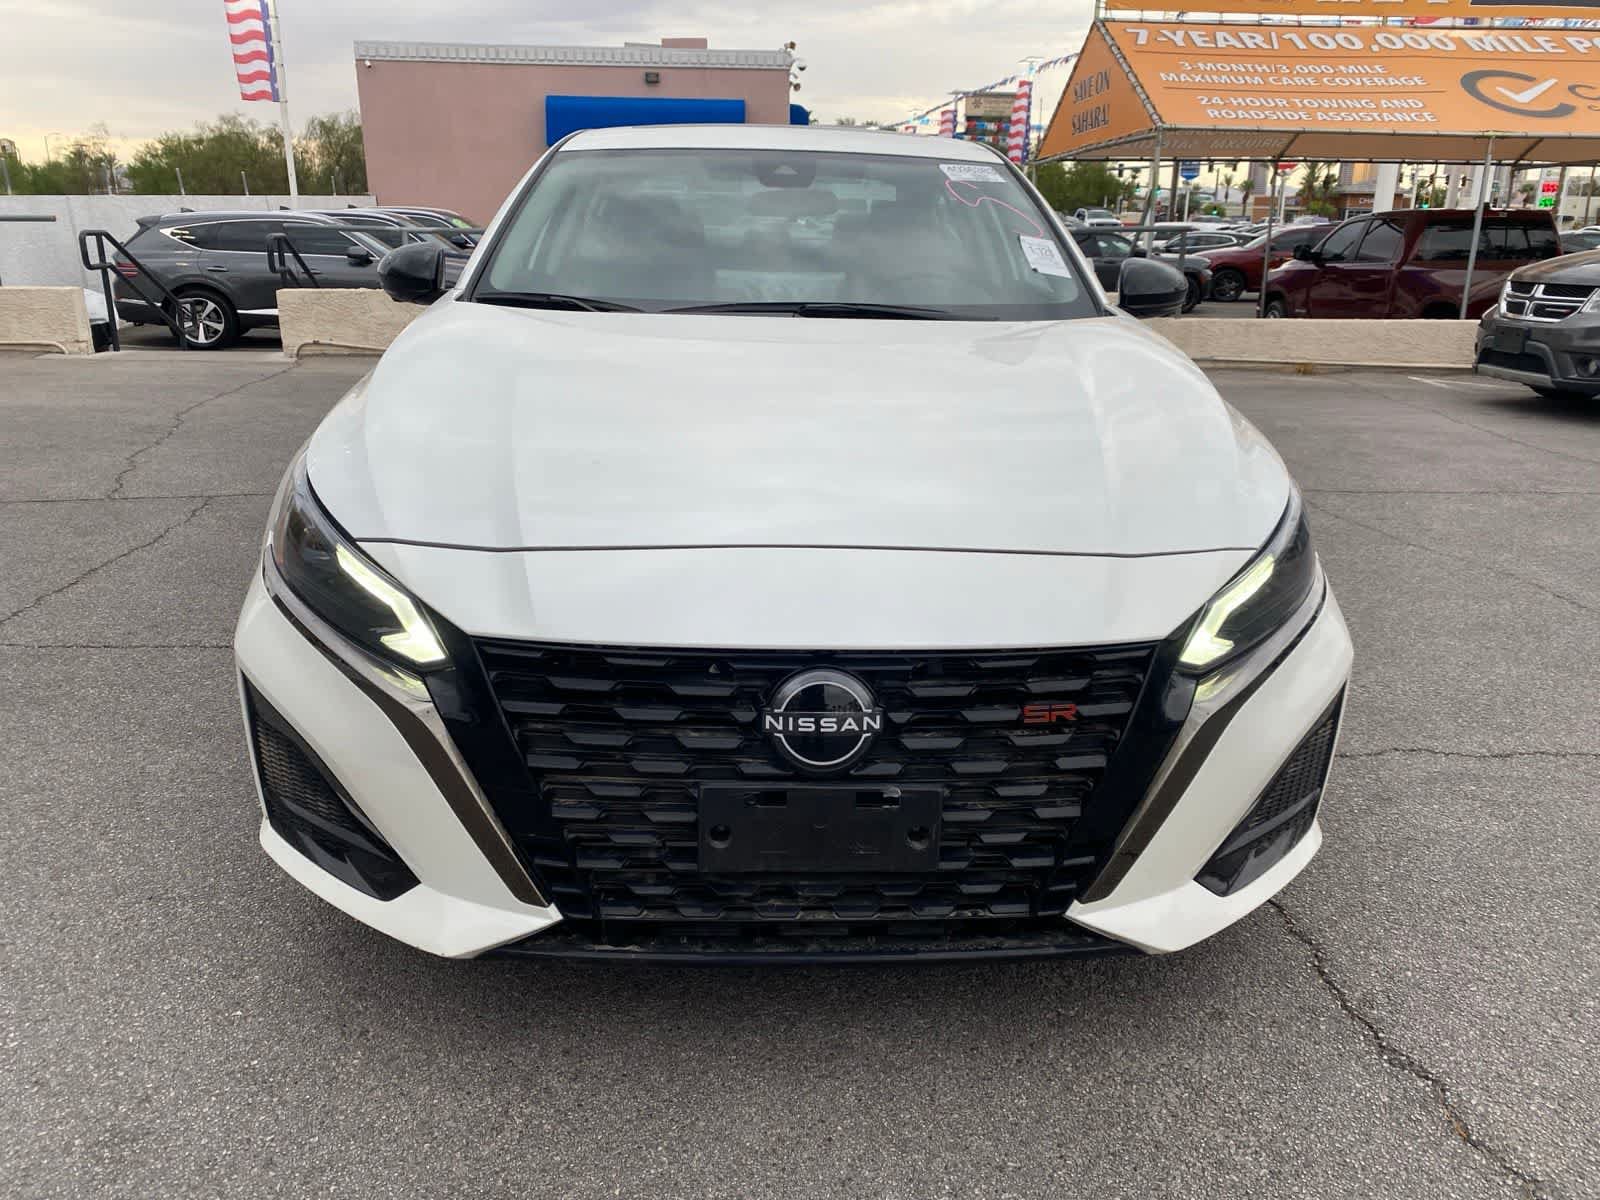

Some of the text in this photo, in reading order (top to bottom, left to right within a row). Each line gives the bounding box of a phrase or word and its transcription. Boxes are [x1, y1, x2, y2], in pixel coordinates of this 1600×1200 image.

[1125, 28, 1457, 52] 7-YEAR/100,000
[1461, 35, 1567, 54] MILE
[1096, 68, 1110, 95] ON
[1159, 72, 1428, 88] MAXIMUM CARE COVERAGE
[1197, 95, 1425, 110] 24-HOUR TOWING AND
[1206, 108, 1438, 123] ROADSIDE ASSISTANCE
[1023, 703, 1077, 723] SR
[764, 714, 881, 733] NISSAN
